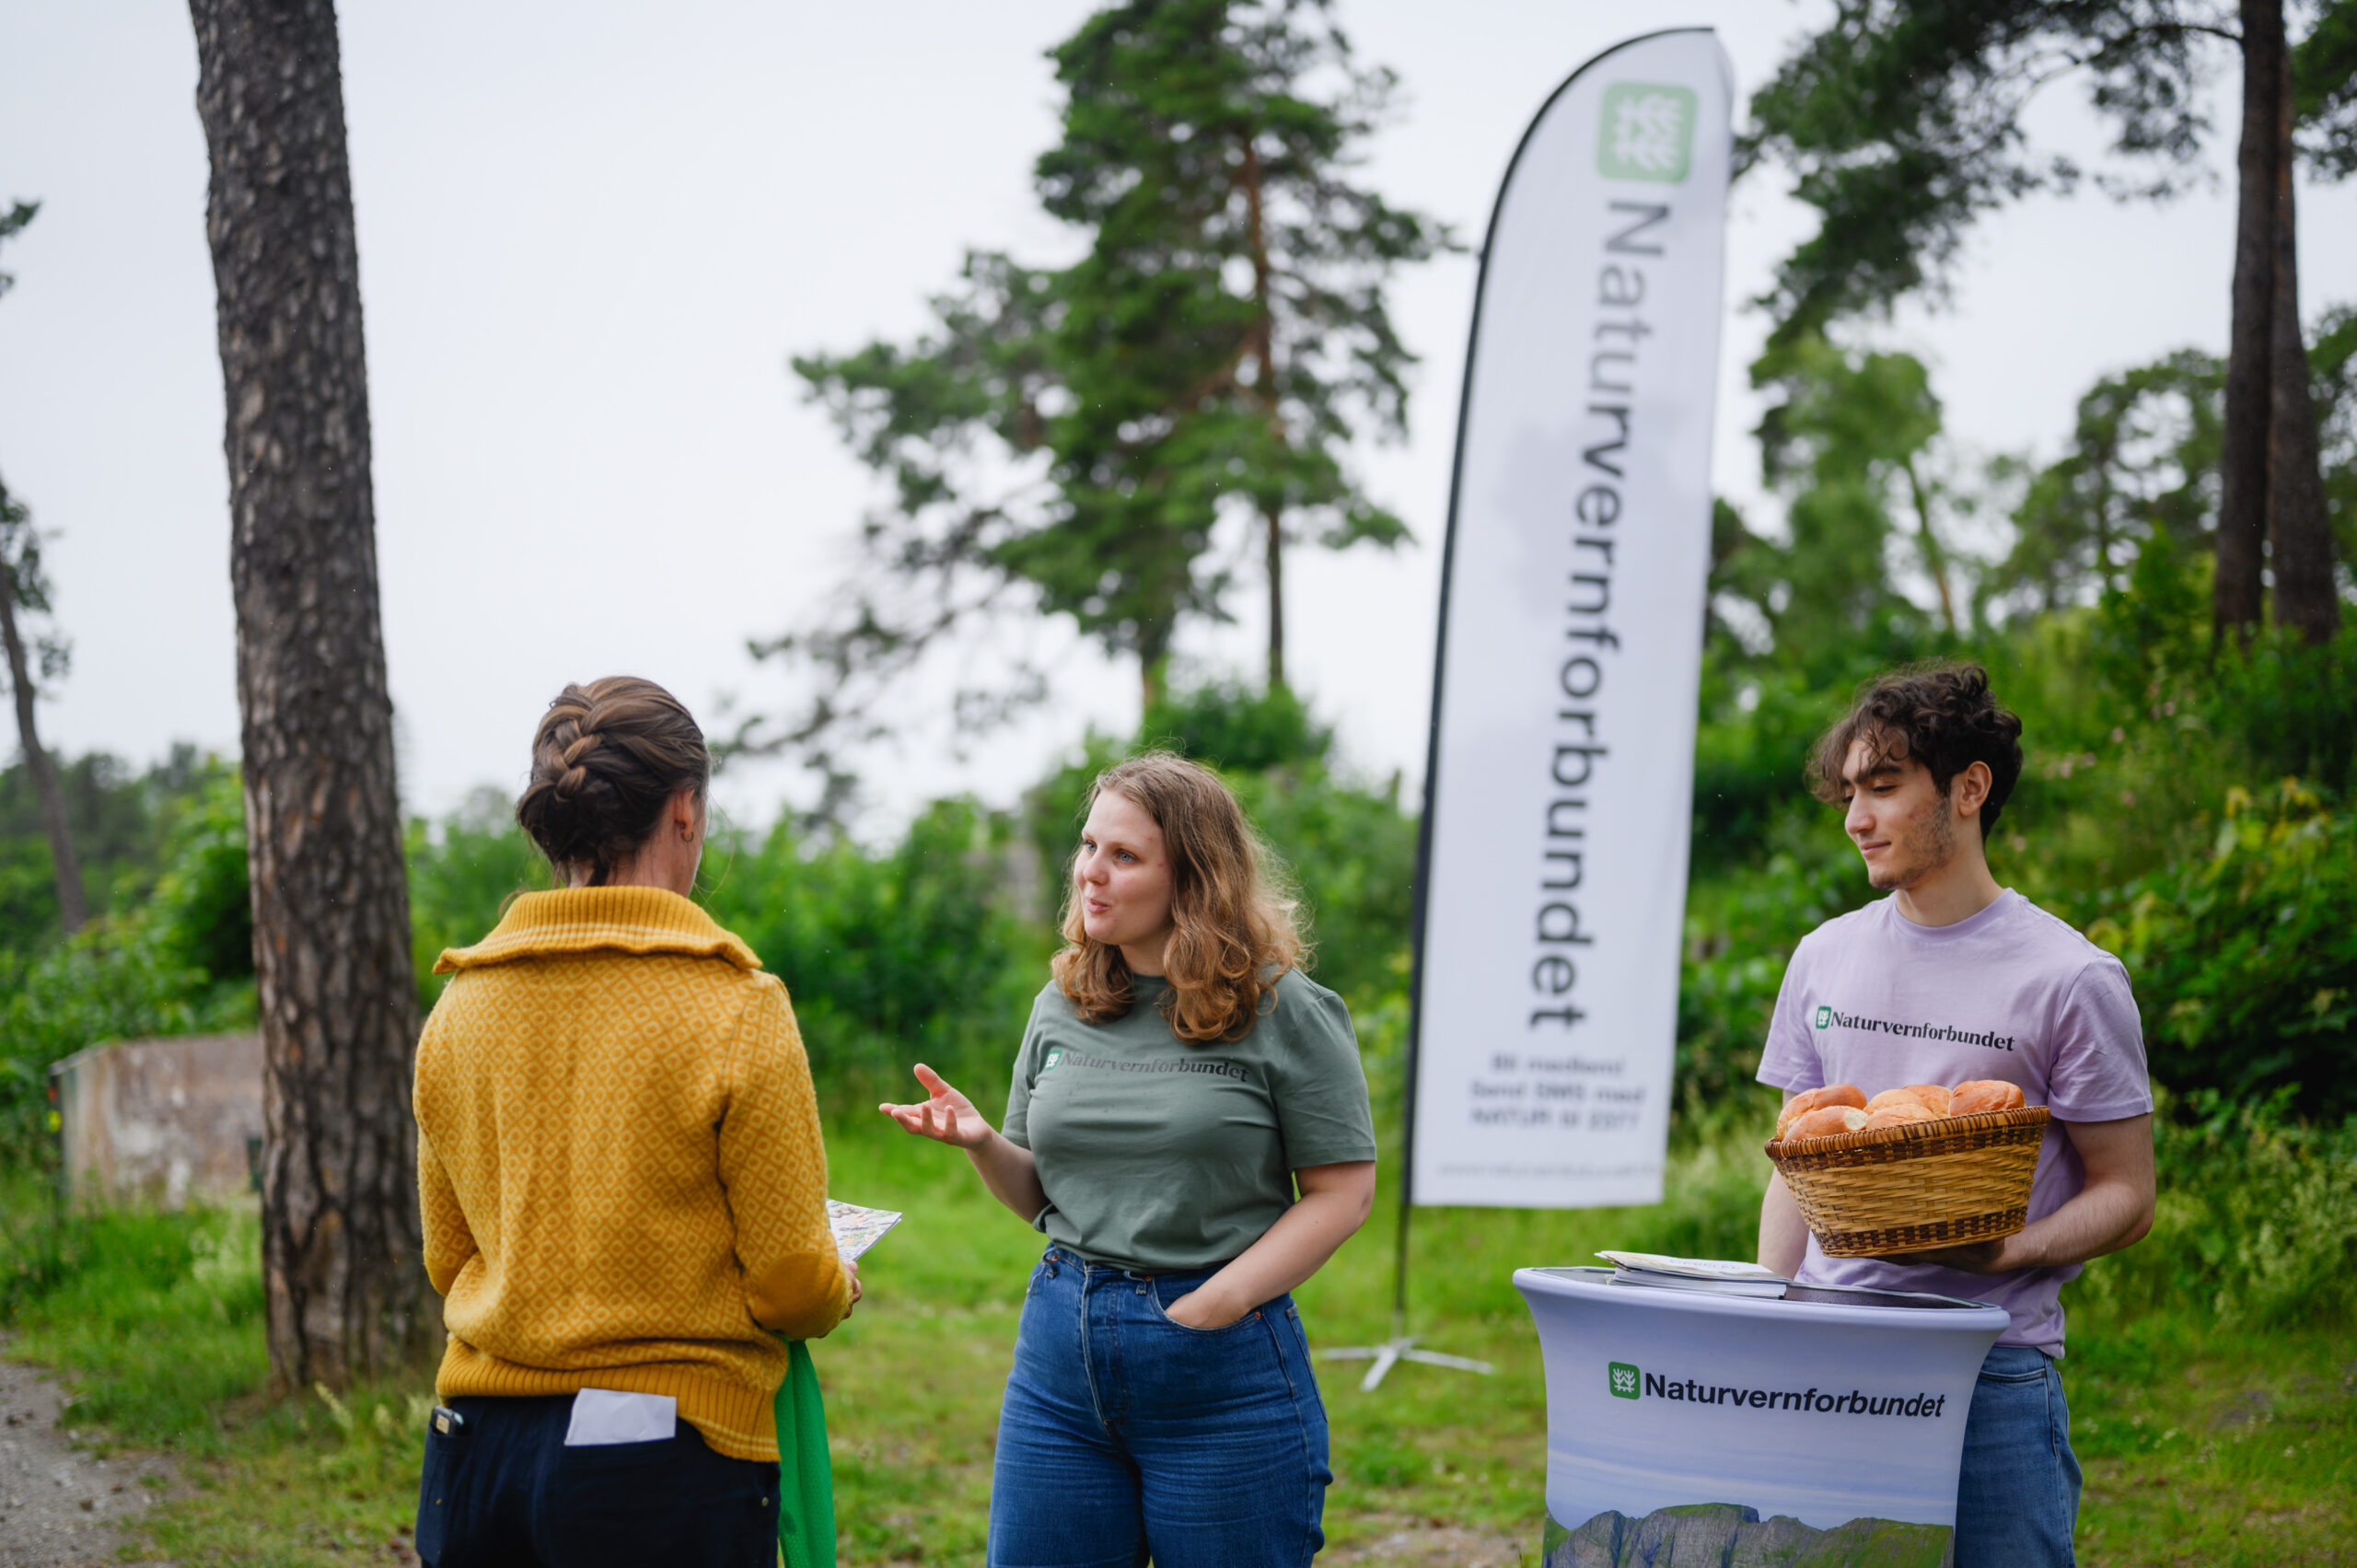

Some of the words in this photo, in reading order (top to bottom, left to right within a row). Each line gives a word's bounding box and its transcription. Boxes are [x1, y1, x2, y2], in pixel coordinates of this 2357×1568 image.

[1531, 201, 1668, 1029] Naturvernforbundet
[1829, 1011, 2014, 1051] Naturvernforbundet
[1060, 1052, 1249, 1083] Naturvernforbundet
[1644, 1373, 1945, 1418] Naturvernforbundet
